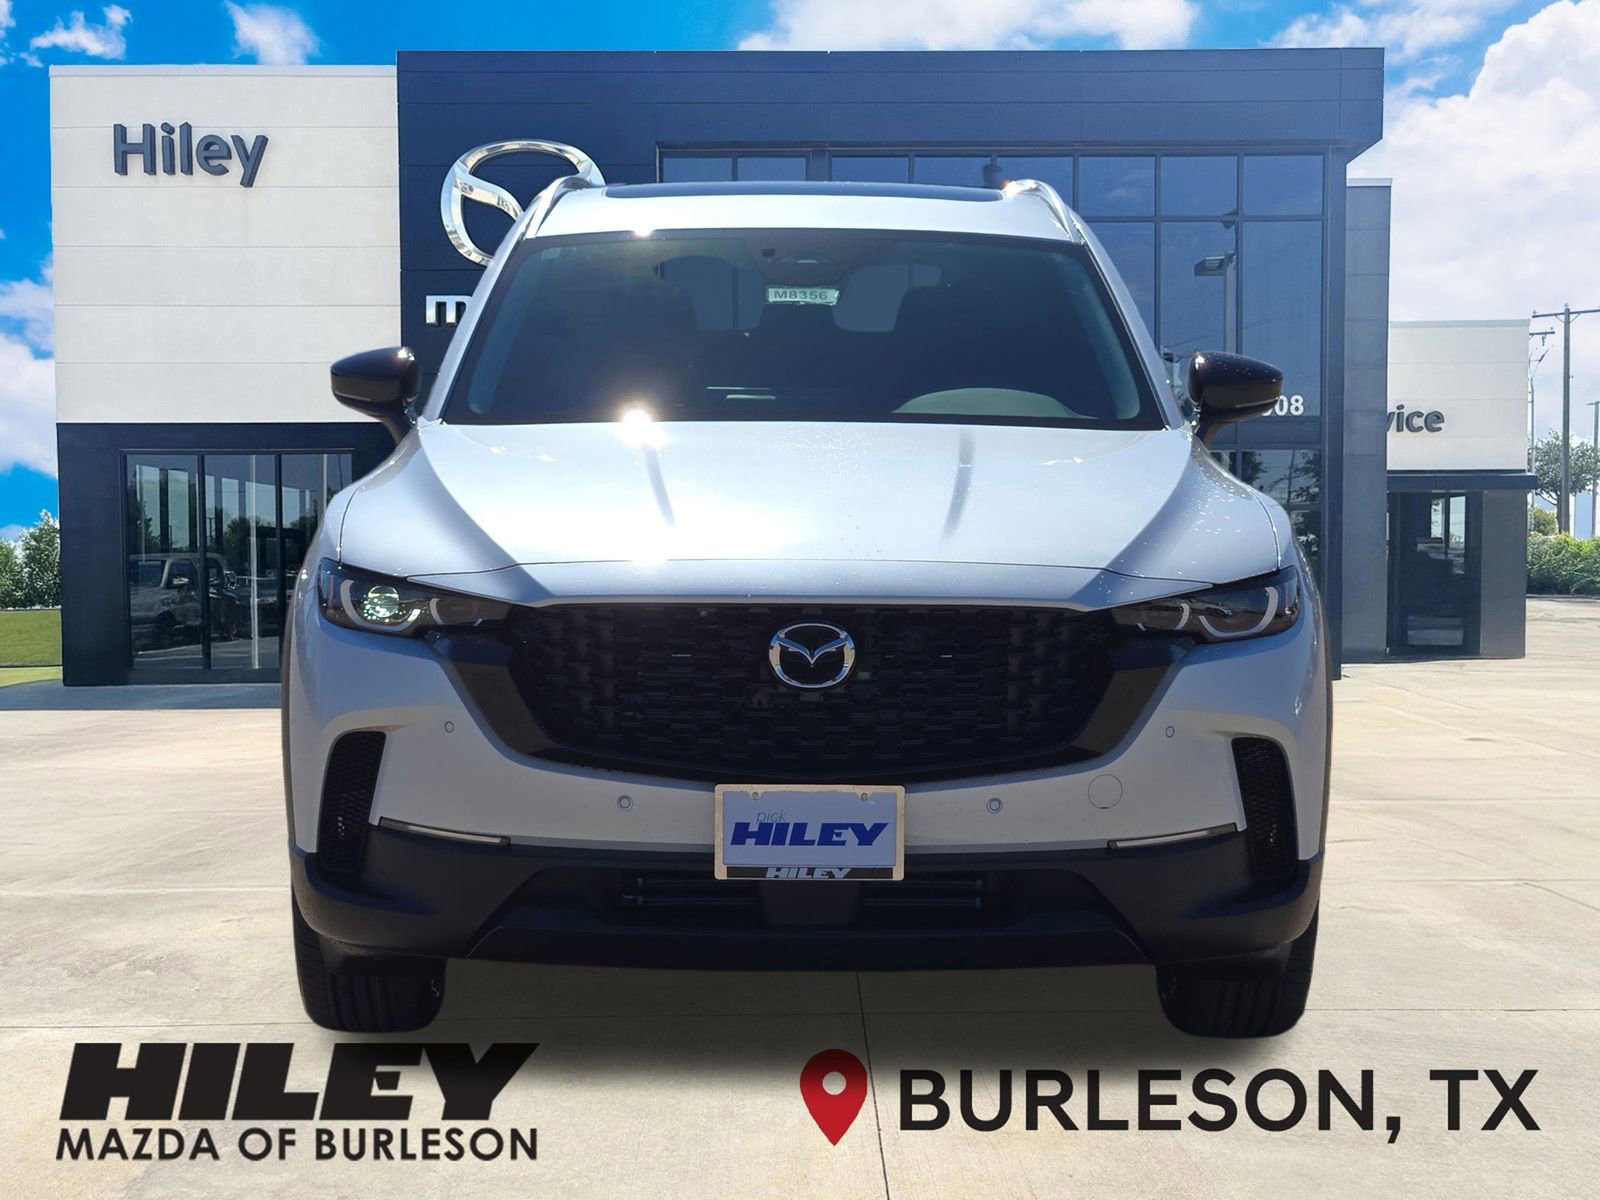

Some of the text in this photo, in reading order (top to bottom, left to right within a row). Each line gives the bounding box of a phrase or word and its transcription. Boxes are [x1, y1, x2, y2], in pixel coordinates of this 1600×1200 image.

[113, 121, 269, 188] Hiley
[773, 290, 828, 300] M8356
[1261, 394, 1304, 417] 08
[756, 810, 786, 824] pick
[730, 822, 889, 846] HILEY
[765, 867, 852, 879] HILEY
